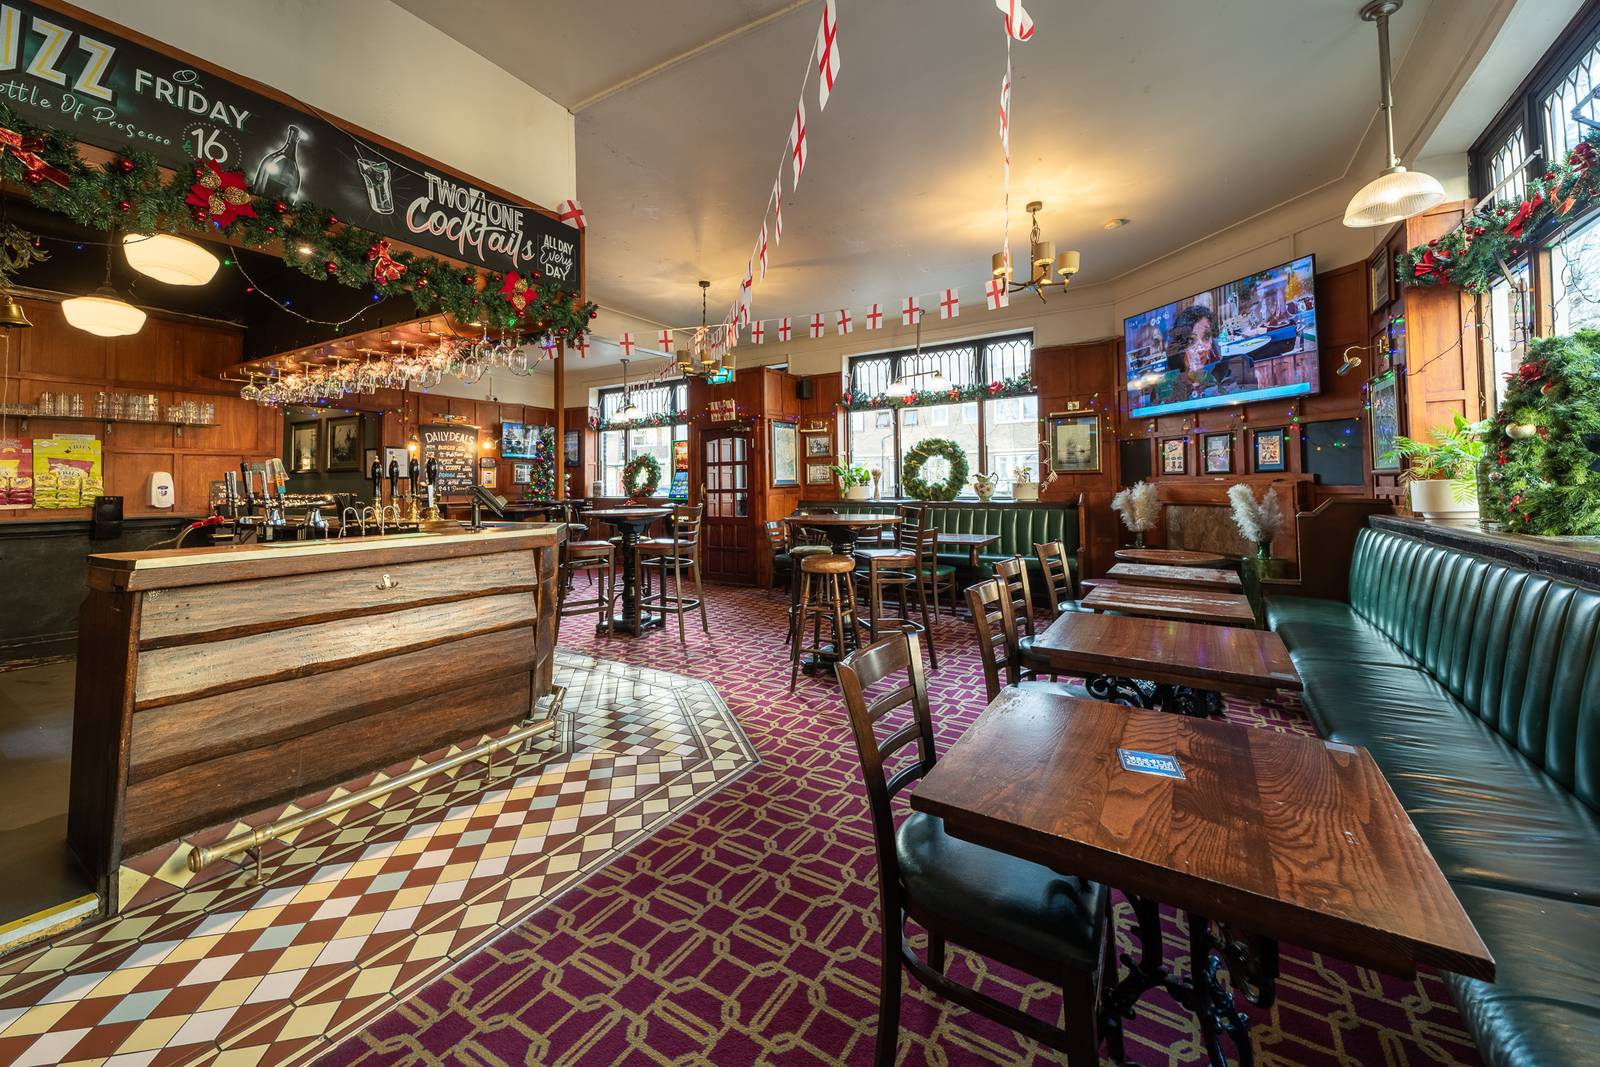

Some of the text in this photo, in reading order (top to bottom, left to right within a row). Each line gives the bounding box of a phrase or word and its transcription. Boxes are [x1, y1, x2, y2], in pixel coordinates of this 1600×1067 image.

[61, 93, 83, 121] Of
[135, 68, 251, 130] FRIDAY
[543, 234, 573, 256] ALL DAY
[540, 245, 573, 270] Every
[545, 263, 570, 281] DAY
[425, 431, 475, 446] DAILY DEALS
